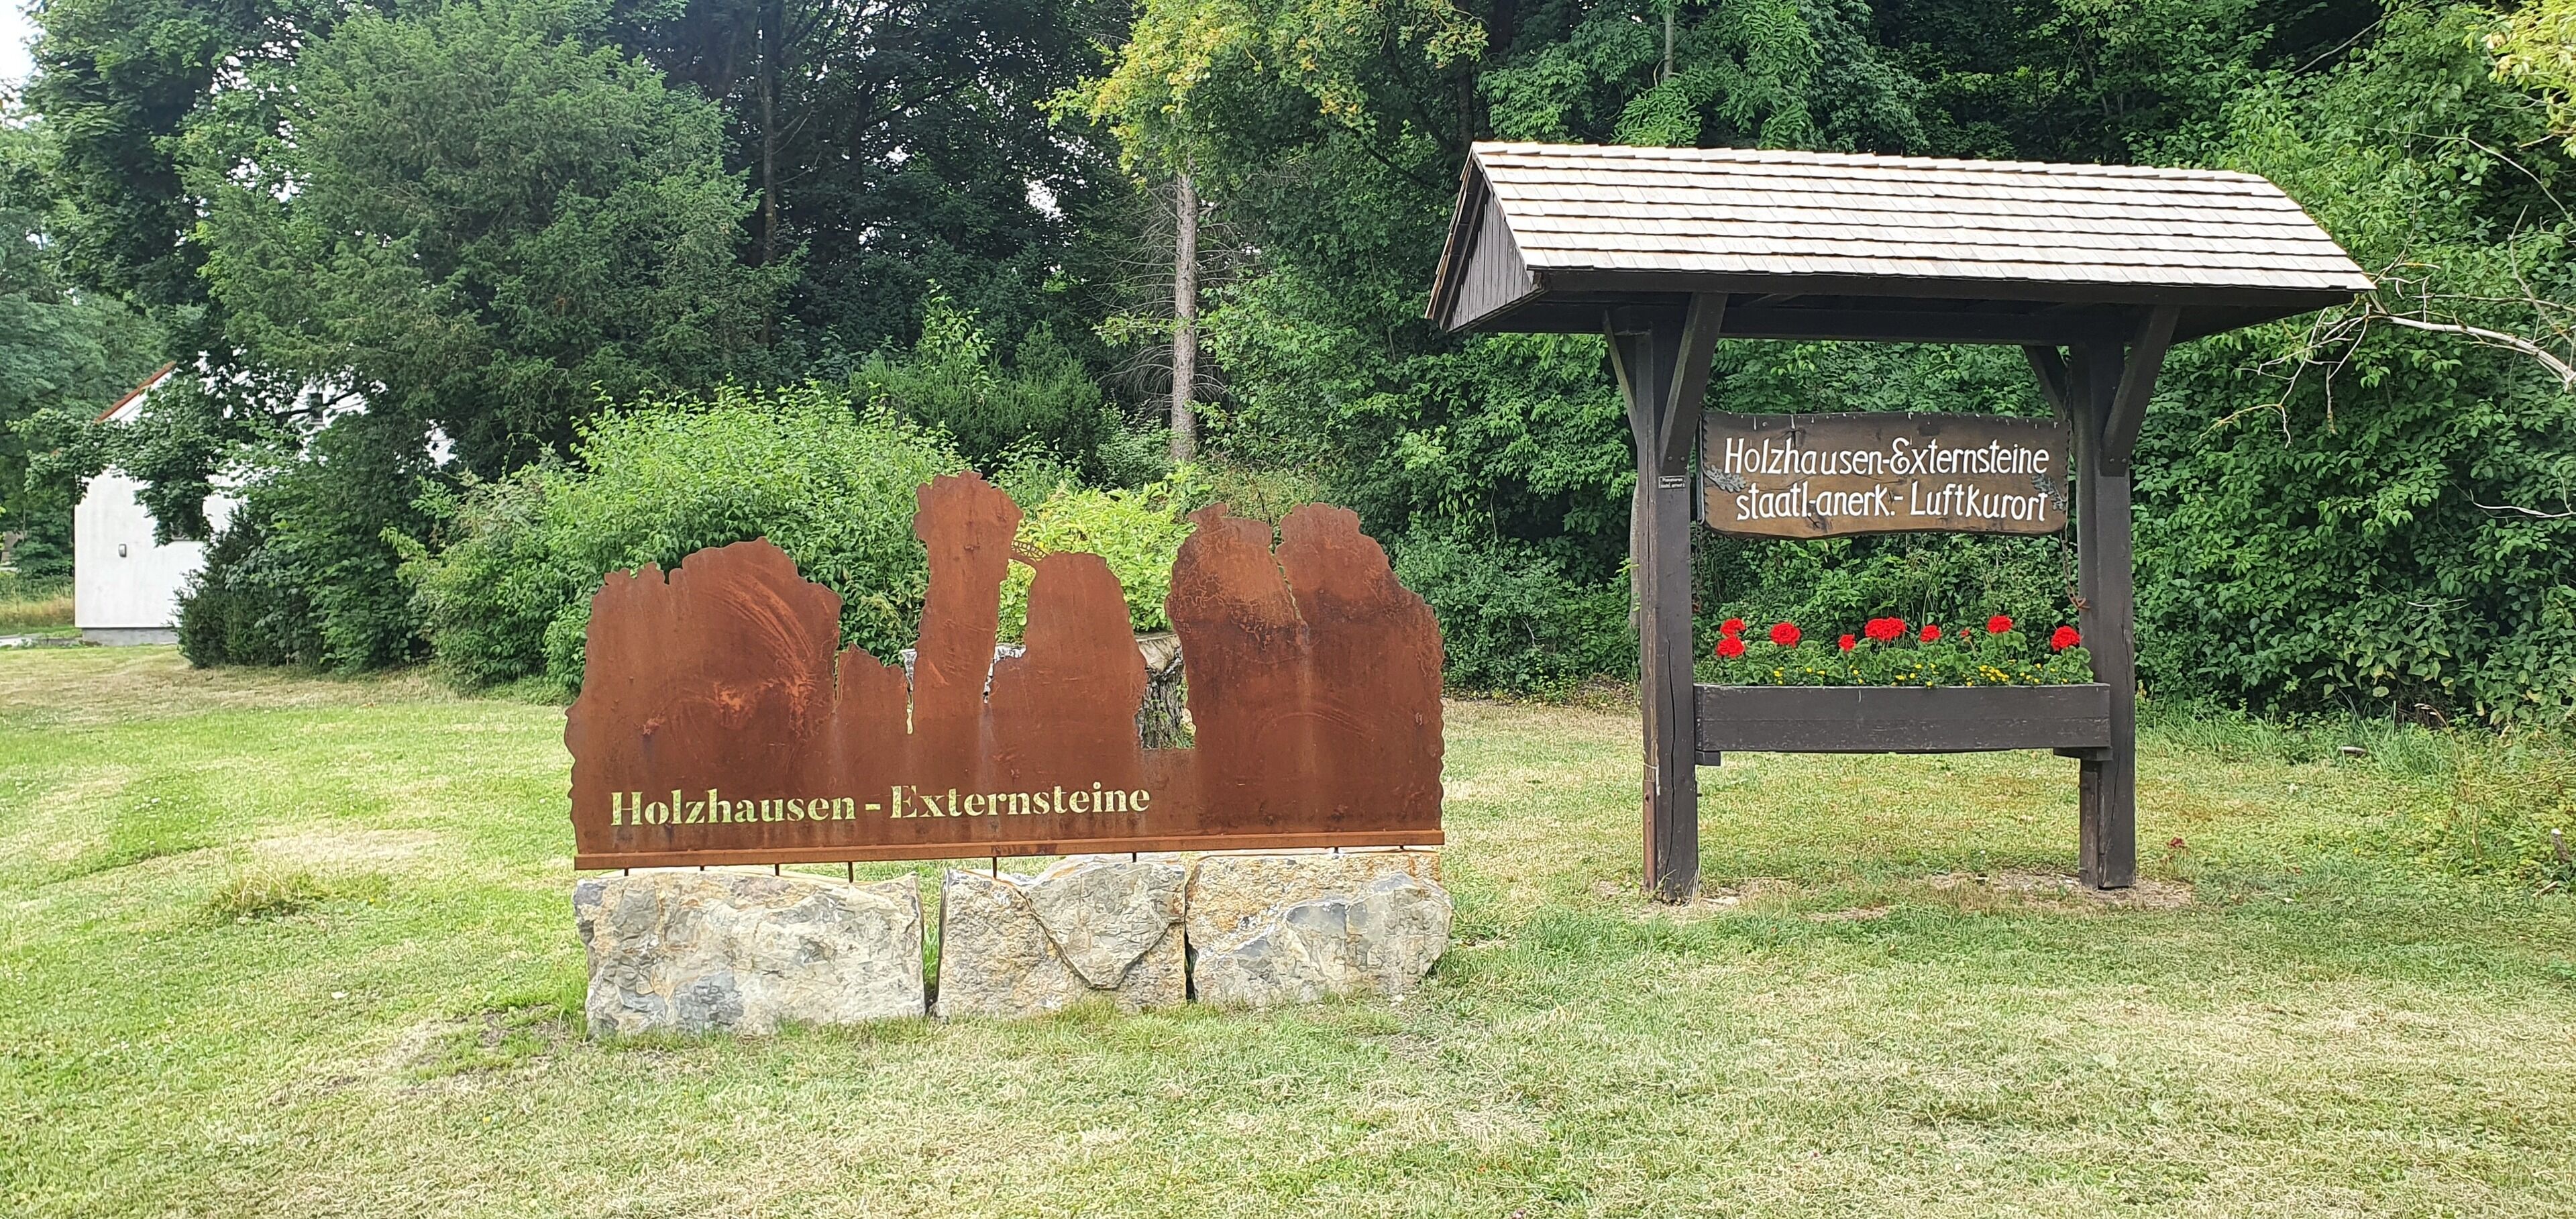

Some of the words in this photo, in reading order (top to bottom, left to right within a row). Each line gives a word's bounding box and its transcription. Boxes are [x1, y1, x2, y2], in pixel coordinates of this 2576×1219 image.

[1723, 436, 2050, 476] Holzhausen-Externsteine
[1909, 480, 2049, 522] Luftkurort
[610, 788, 857, 827] Holzhausen
[890, 781, 1150, 819] Externsteine
